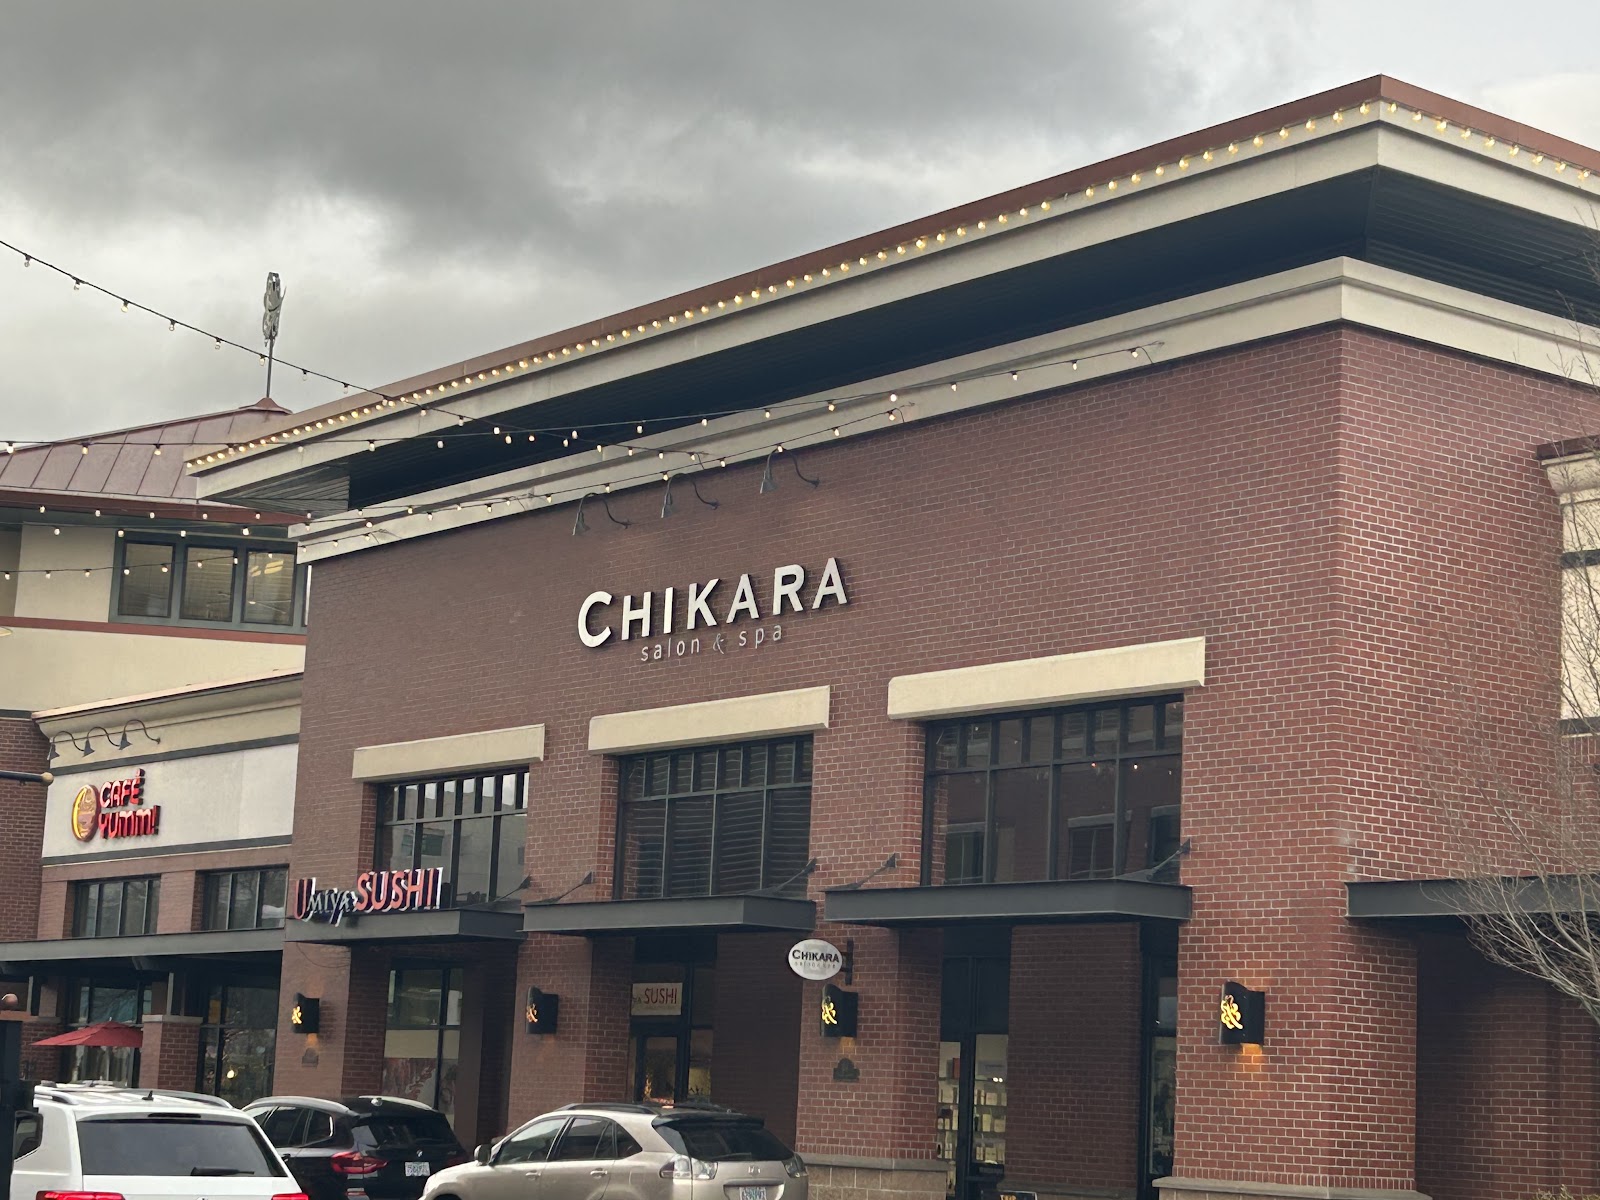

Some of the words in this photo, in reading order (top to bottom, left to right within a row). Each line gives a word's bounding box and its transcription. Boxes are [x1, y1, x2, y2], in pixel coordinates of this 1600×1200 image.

[577, 557, 849, 648] CHIKARA
[641, 636, 700, 661] salon
[712, 633, 725, 655] &
[738, 624, 783, 649] spa
[355, 867, 444, 912] SUSHI
[792, 949, 840, 963] CHIKARA
[644, 987, 678, 1005] SUSHI
